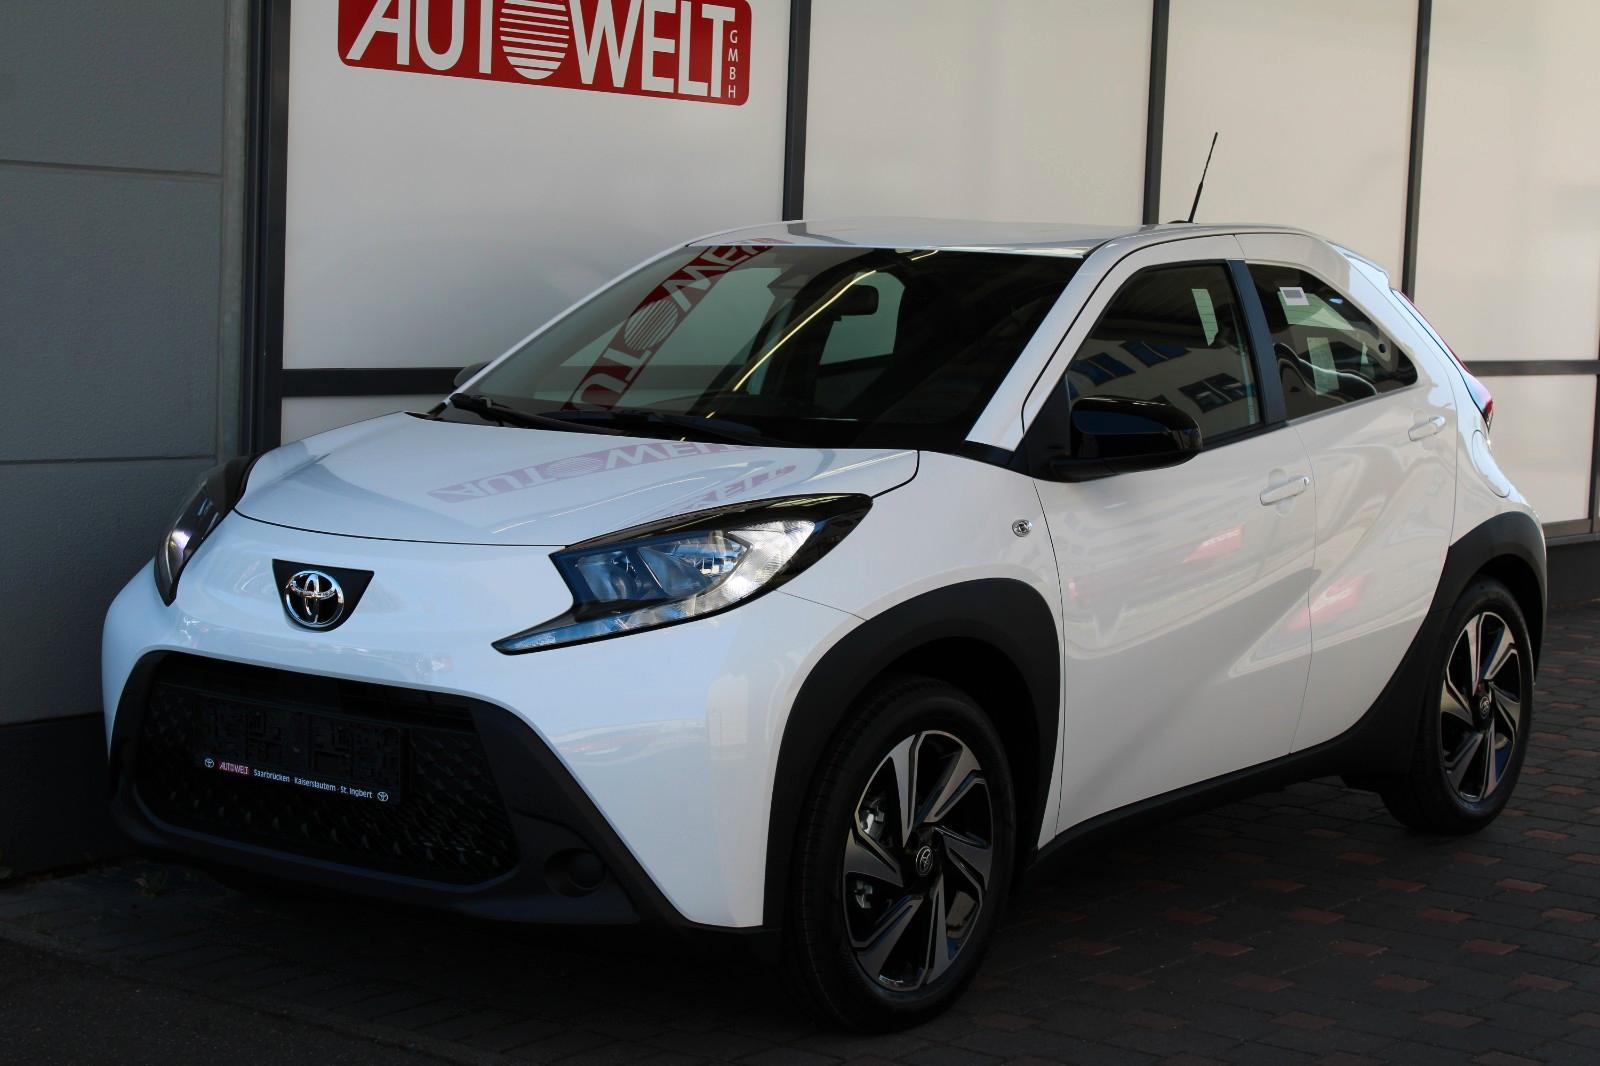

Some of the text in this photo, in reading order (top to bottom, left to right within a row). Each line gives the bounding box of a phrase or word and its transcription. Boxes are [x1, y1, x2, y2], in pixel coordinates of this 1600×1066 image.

[346, 0, 736, 98] AUTOWELT
[727, 29, 739, 99] GMBH
[218, 761, 249, 775] AUTOWELT
[349, 787, 373, 799] Ingbert
